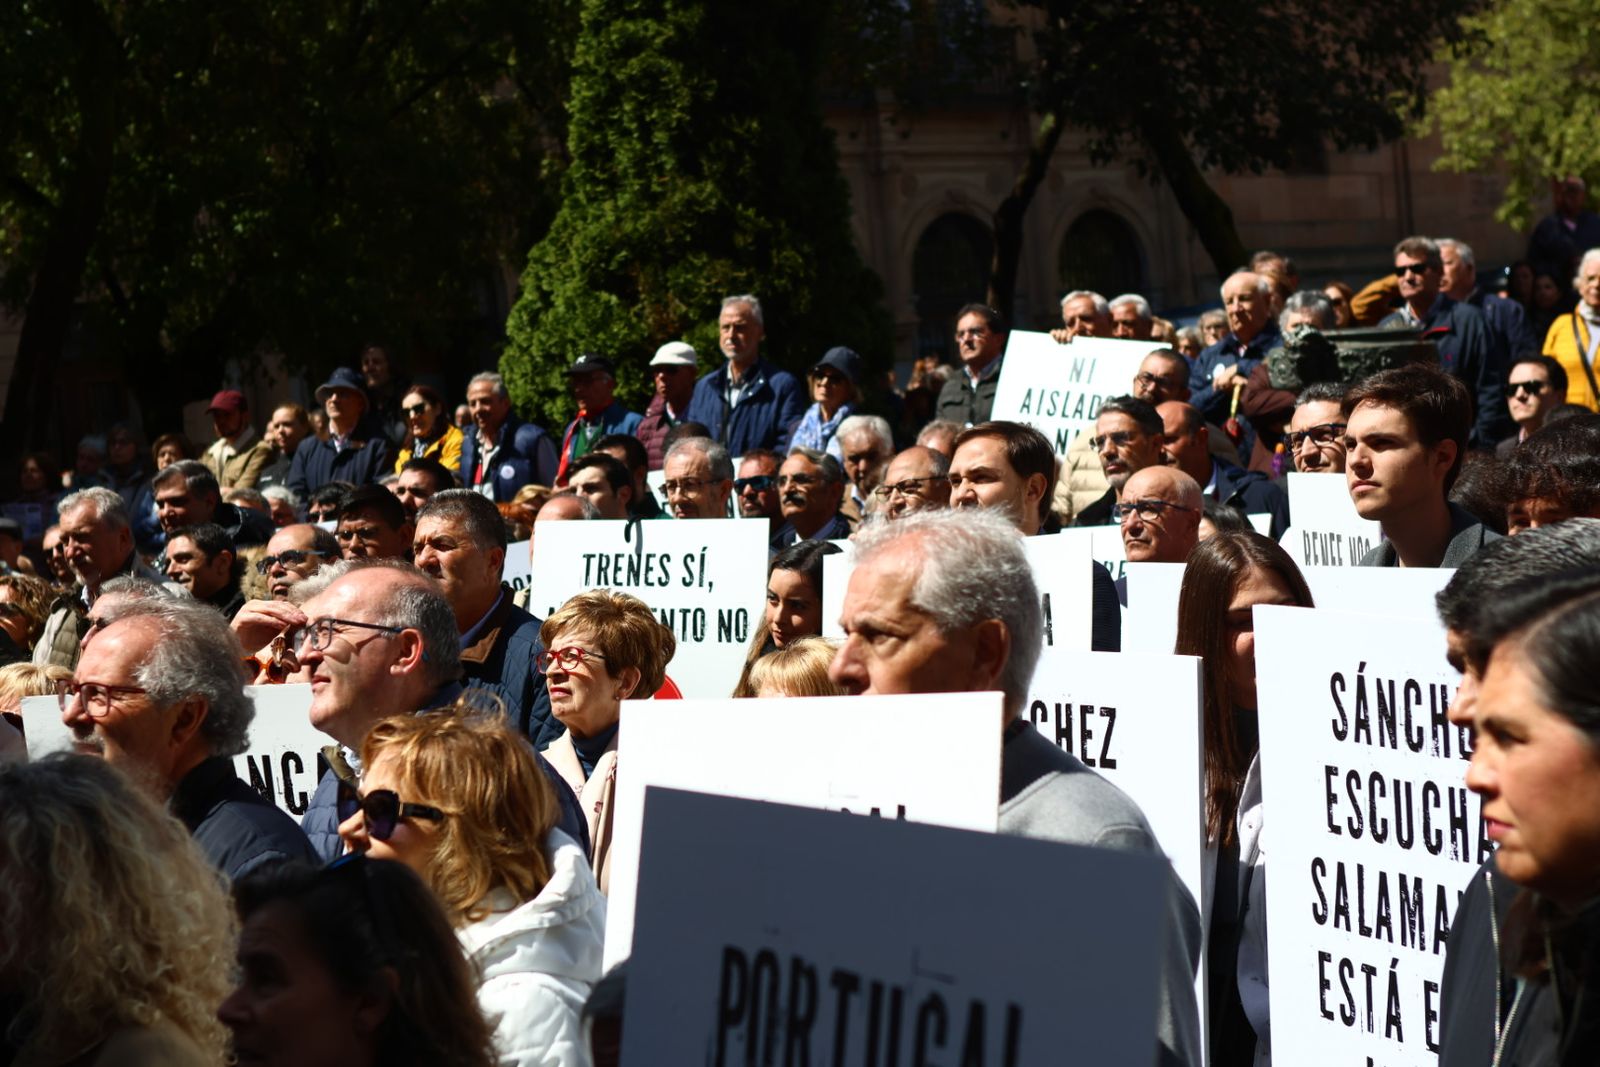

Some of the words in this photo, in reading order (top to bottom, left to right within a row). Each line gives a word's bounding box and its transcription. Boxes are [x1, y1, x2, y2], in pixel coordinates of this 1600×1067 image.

[1069, 357, 1096, 384] NI
[1020, 388, 1114, 421] AISLAD
[582, 552, 671, 588] TRENES
[682, 547, 714, 593] SÍ,
[718, 608, 748, 643] NO
[1311, 857, 1464, 955] SALAMA
[1318, 950, 1404, 1043] ESTÁ
